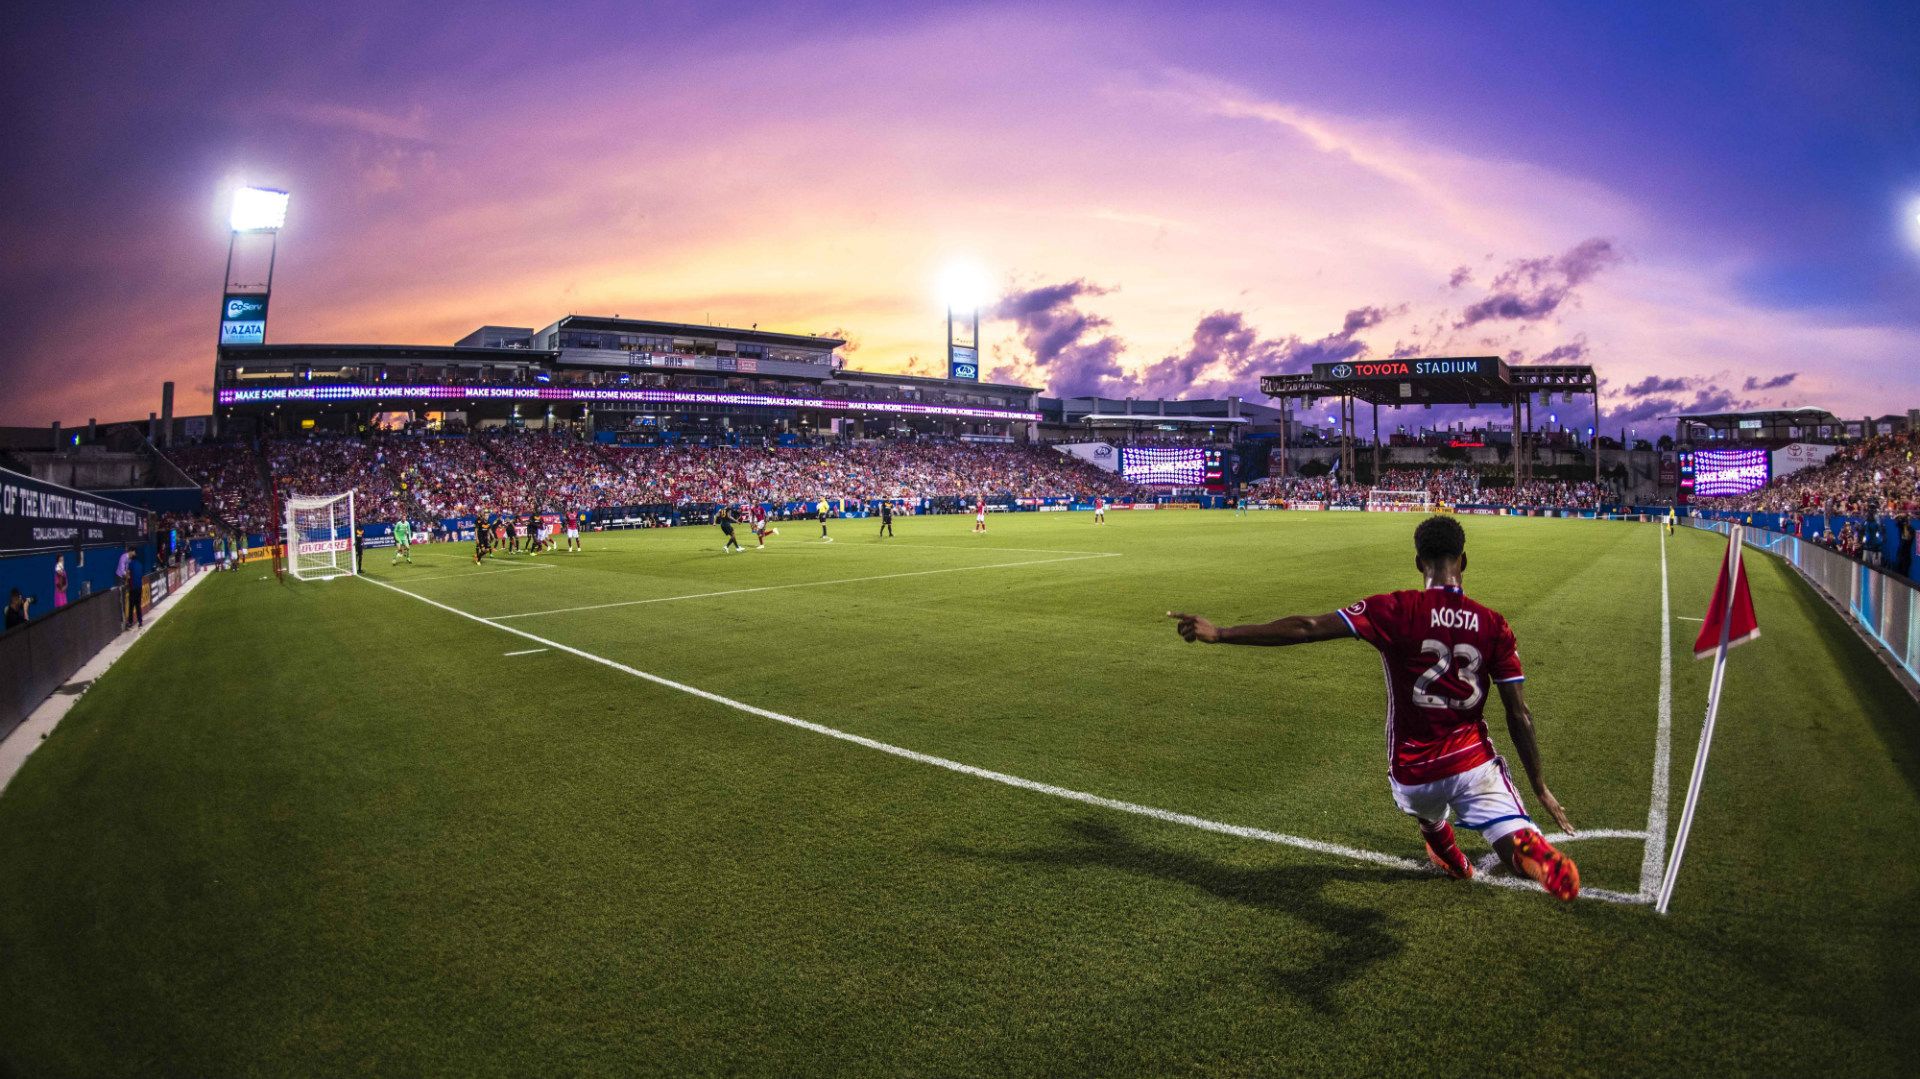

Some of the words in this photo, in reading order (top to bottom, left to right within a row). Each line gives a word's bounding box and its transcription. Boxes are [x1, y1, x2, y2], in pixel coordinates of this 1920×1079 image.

[230, 302, 263, 311] CoServ
[224, 325, 262, 335] VAZATA
[1355, 363, 1409, 376] TOYOTA
[1416, 361, 1478, 374] STADIUM
[235, 391, 260, 400] MAKE
[261, 389, 286, 399] SOME
[288, 388, 315, 398] NOISE
[352, 387, 376, 397] MAKE
[378, 387, 402, 396] SOME
[404, 387, 429, 397] NOISE
[465, 388, 489, 397] MAKE
[490, 388, 513, 397] SOME
[515, 389, 539, 398] NOISE
[572, 390, 595, 399] MAKE
[596, 391, 618, 400] SOME
[620, 391, 642, 400] NOISE
[674, 393, 695, 402] MAKE
[696, 394, 716, 403] SOME
[717, 395, 738, 404] NOISE
[3, 484, 17, 515] OF
[20, 488, 38, 517] THE
[40, 492, 74, 520] NATIONAL
[75, 500, 95, 522] SOCCER
[1430, 606, 1479, 632] ACOSTA
[1412, 639, 1483, 710] 23
